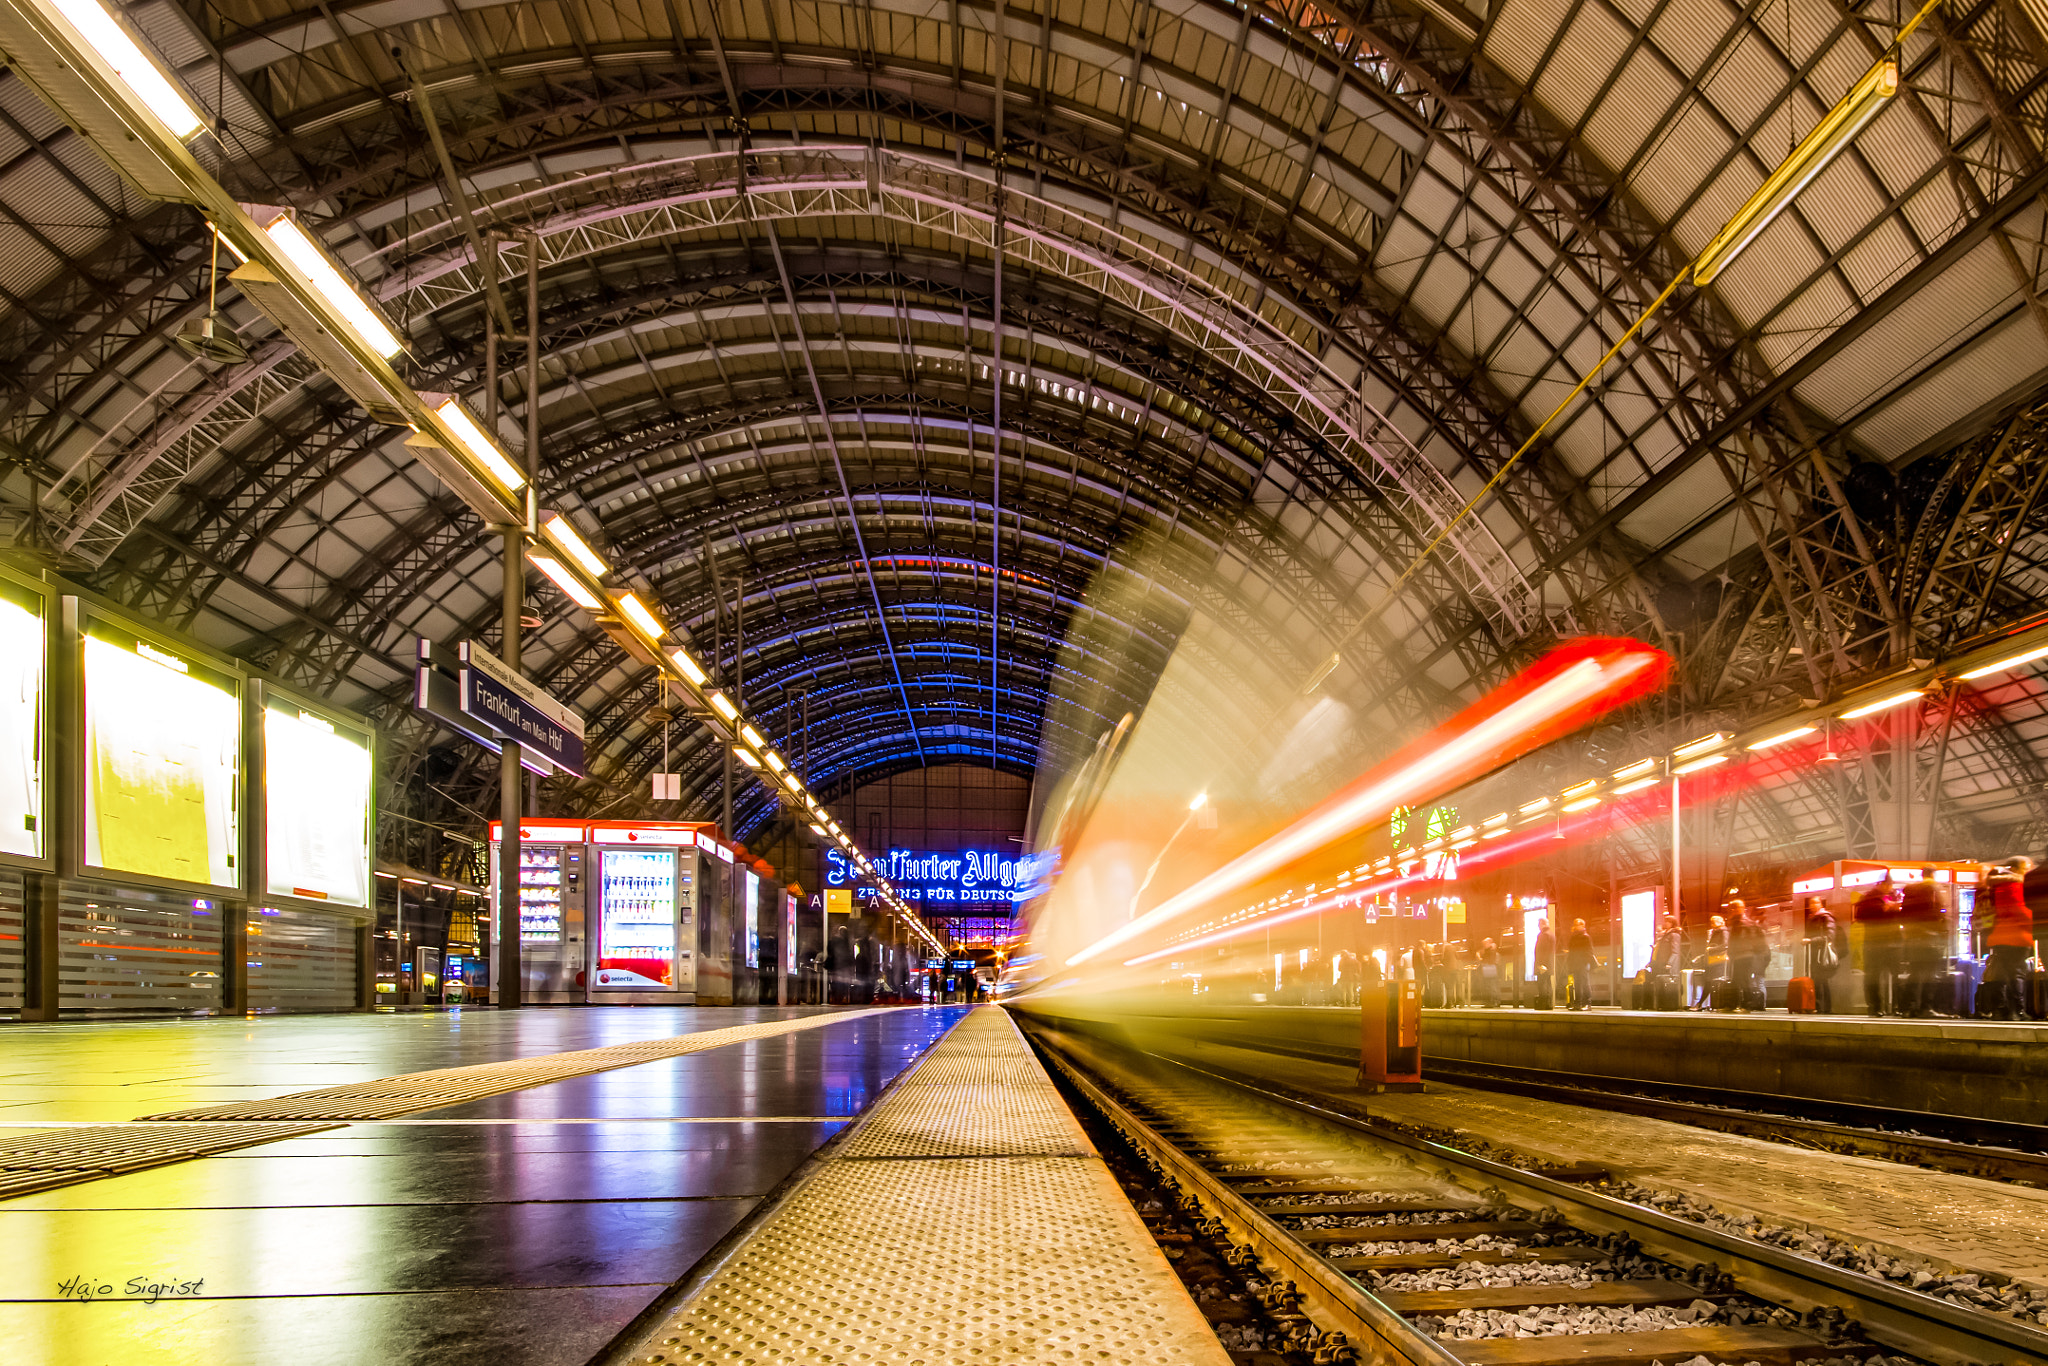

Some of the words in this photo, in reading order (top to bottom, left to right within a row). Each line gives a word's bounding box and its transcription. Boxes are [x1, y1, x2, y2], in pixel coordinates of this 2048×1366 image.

[474, 649, 508, 682] Internationale
[476, 680, 520, 727] Frankfurt
[521, 718, 532, 734] am
[532, 721, 548, 743] Main
[548, 727, 563, 752] Hbf
[827, 848, 961, 884] Frnkfurter
[926, 887, 955, 900] FÜR
[811, 894, 822, 908] A
[869, 895, 880, 908] A
[1366, 904, 1377, 916] A
[1416, 904, 1427, 917] A
